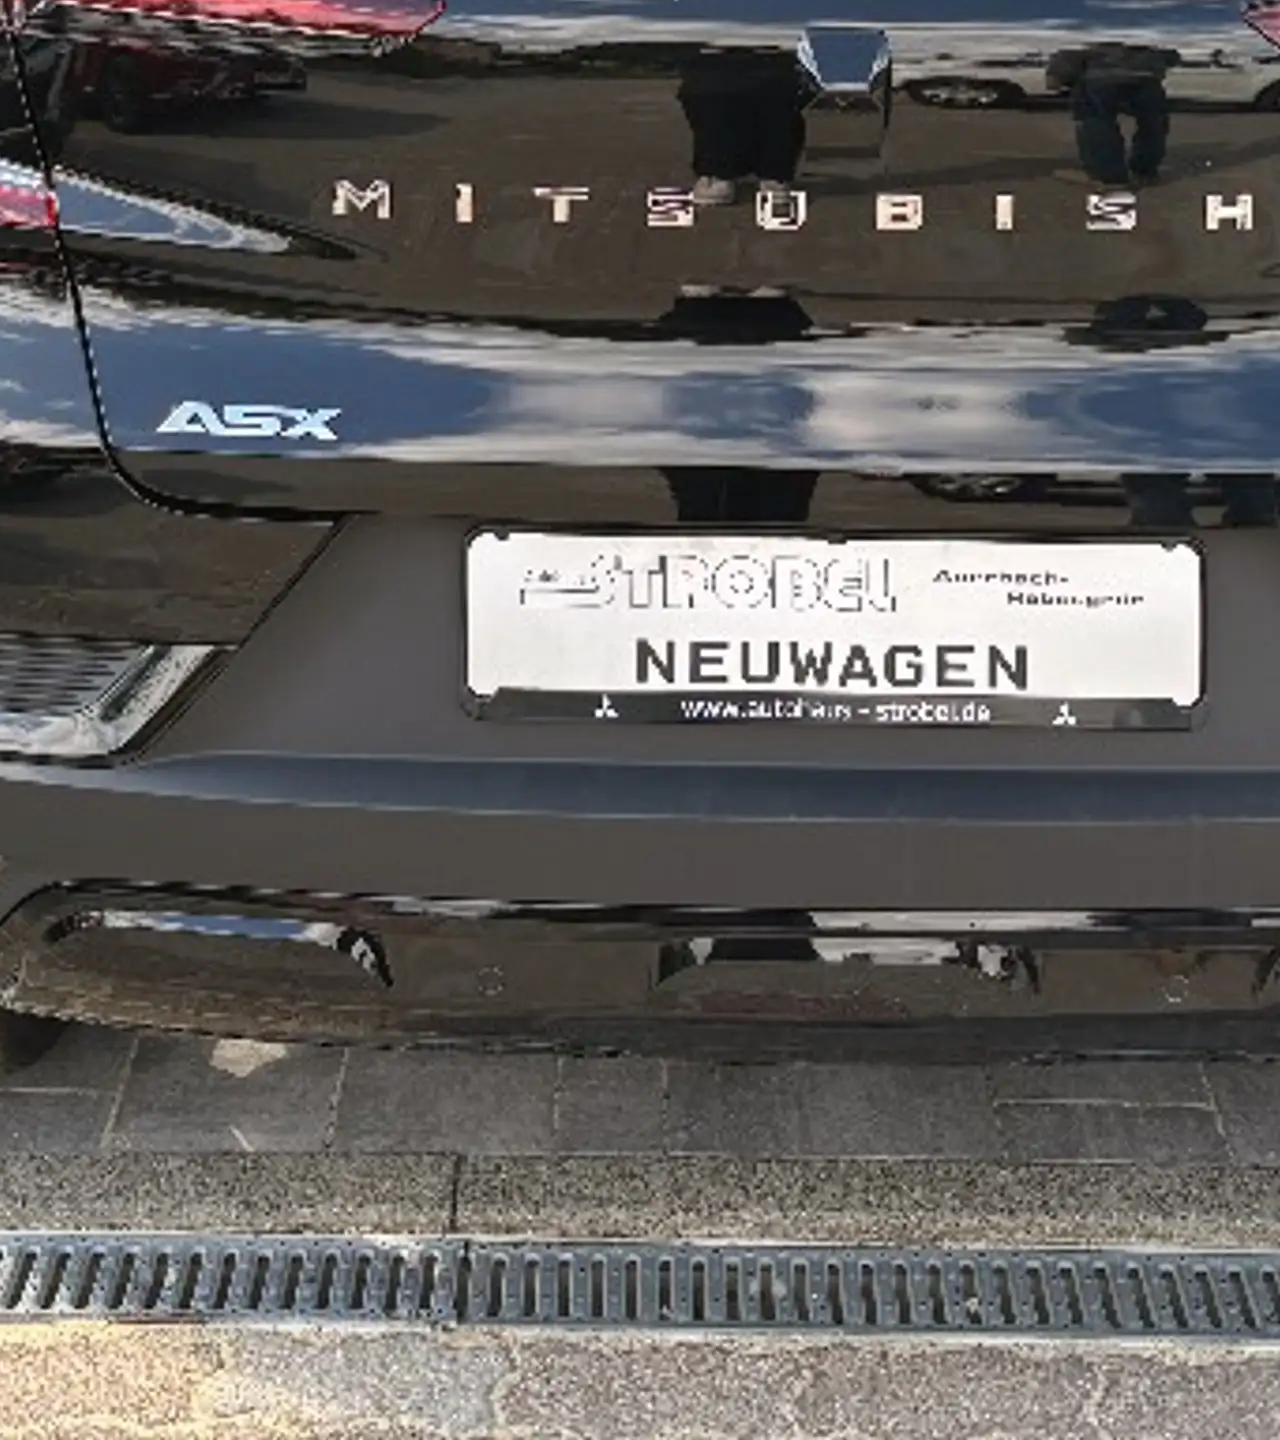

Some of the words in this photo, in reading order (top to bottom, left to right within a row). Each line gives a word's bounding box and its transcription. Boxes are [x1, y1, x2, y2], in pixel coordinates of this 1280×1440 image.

[156, 401, 342, 442] ASX
[582, 554, 898, 613] STROBEL
[632, 637, 1031, 691] NEUWAGEN
